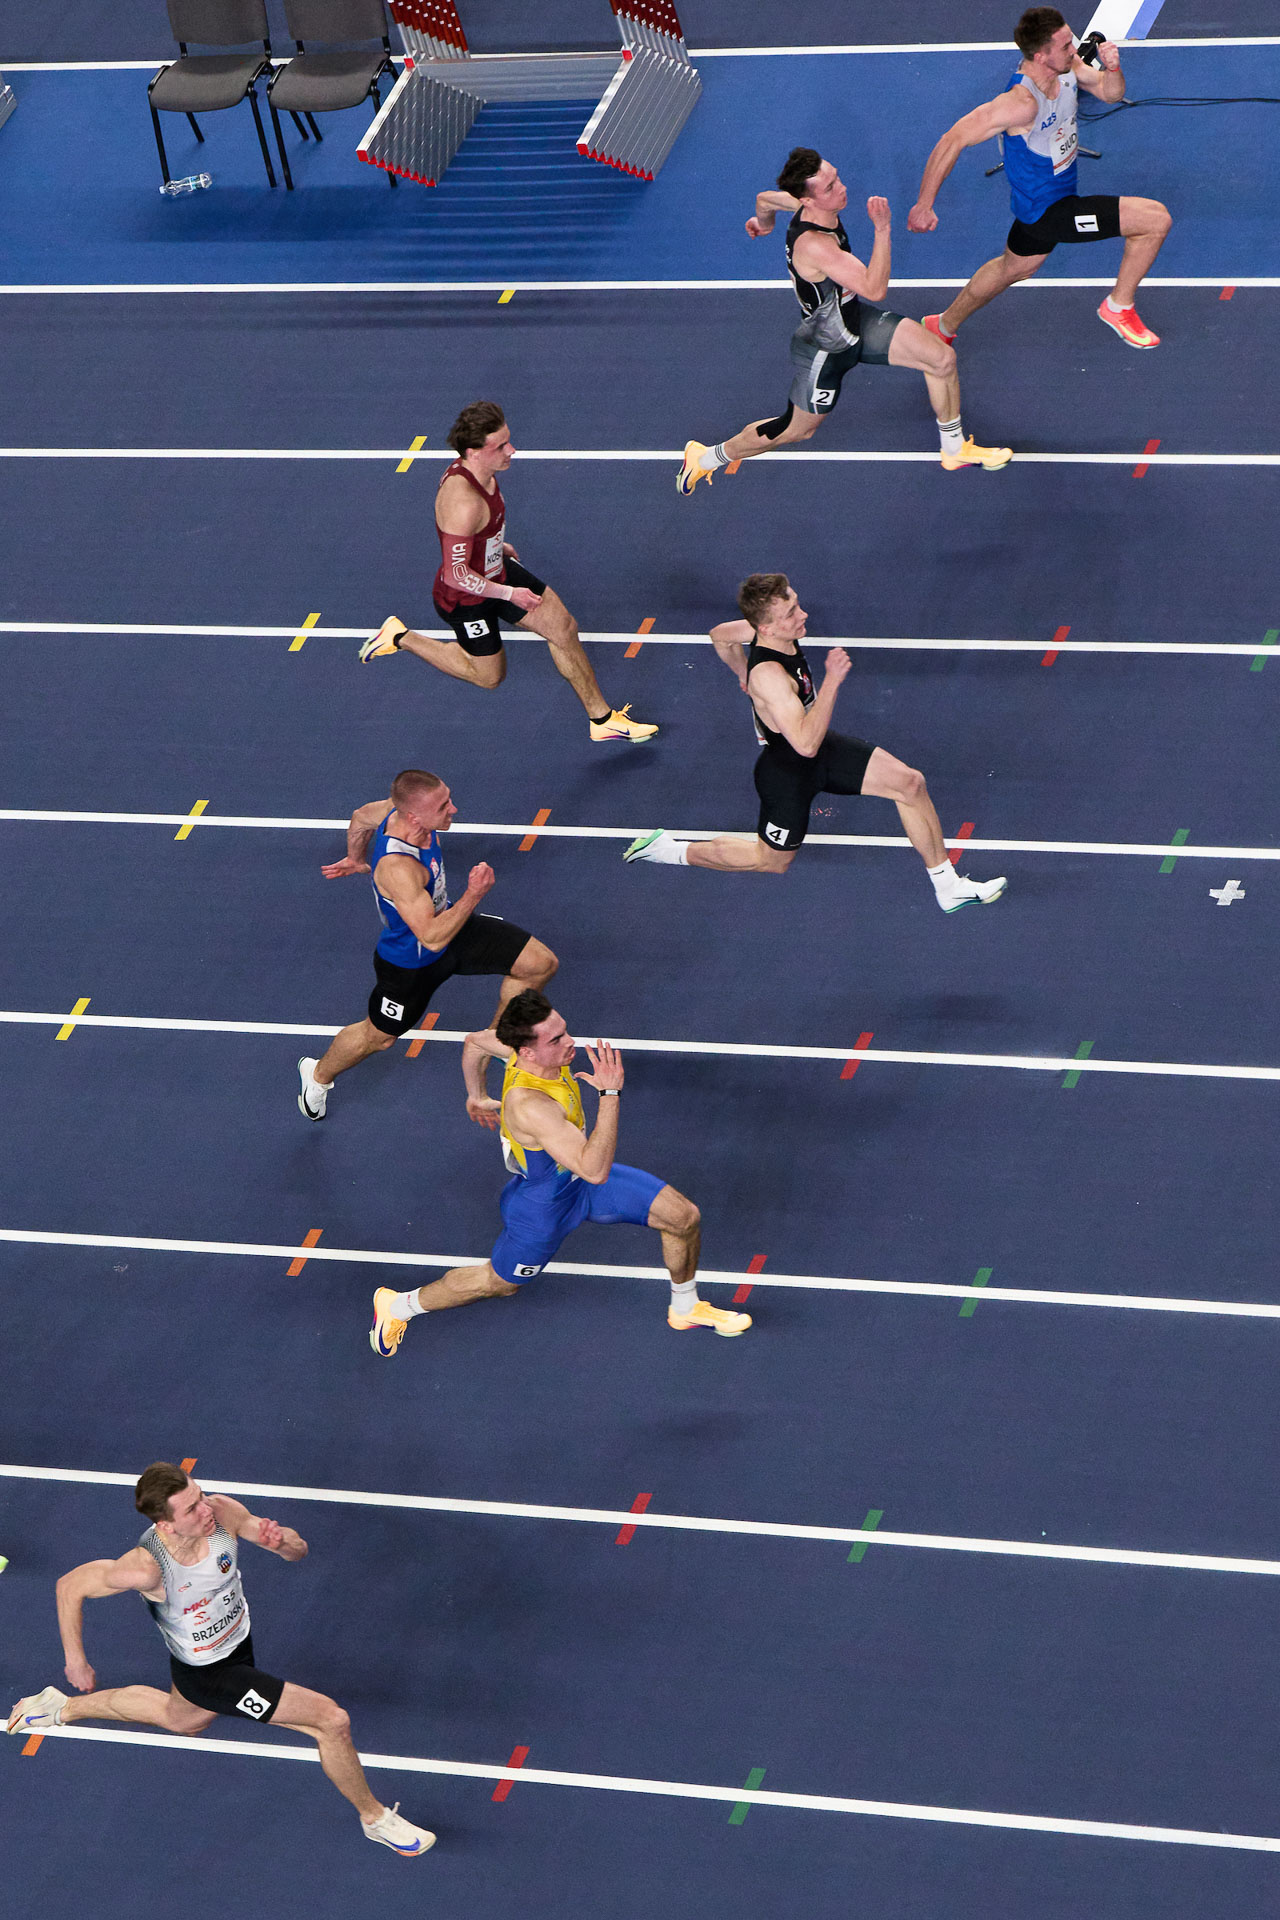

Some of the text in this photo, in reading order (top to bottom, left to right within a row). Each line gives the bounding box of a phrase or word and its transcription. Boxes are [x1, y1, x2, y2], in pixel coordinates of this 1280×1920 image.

[1041, 111, 1057, 131] AZS
[1078, 221, 1095, 229] 1
[816, 391, 830, 404] 2
[470, 622, 484, 636] 3
[769, 829, 782, 841] 4
[385, 1002, 399, 1017] 5
[520, 1266, 535, 1276] 6
[243, 1697, 264, 1714] 8
